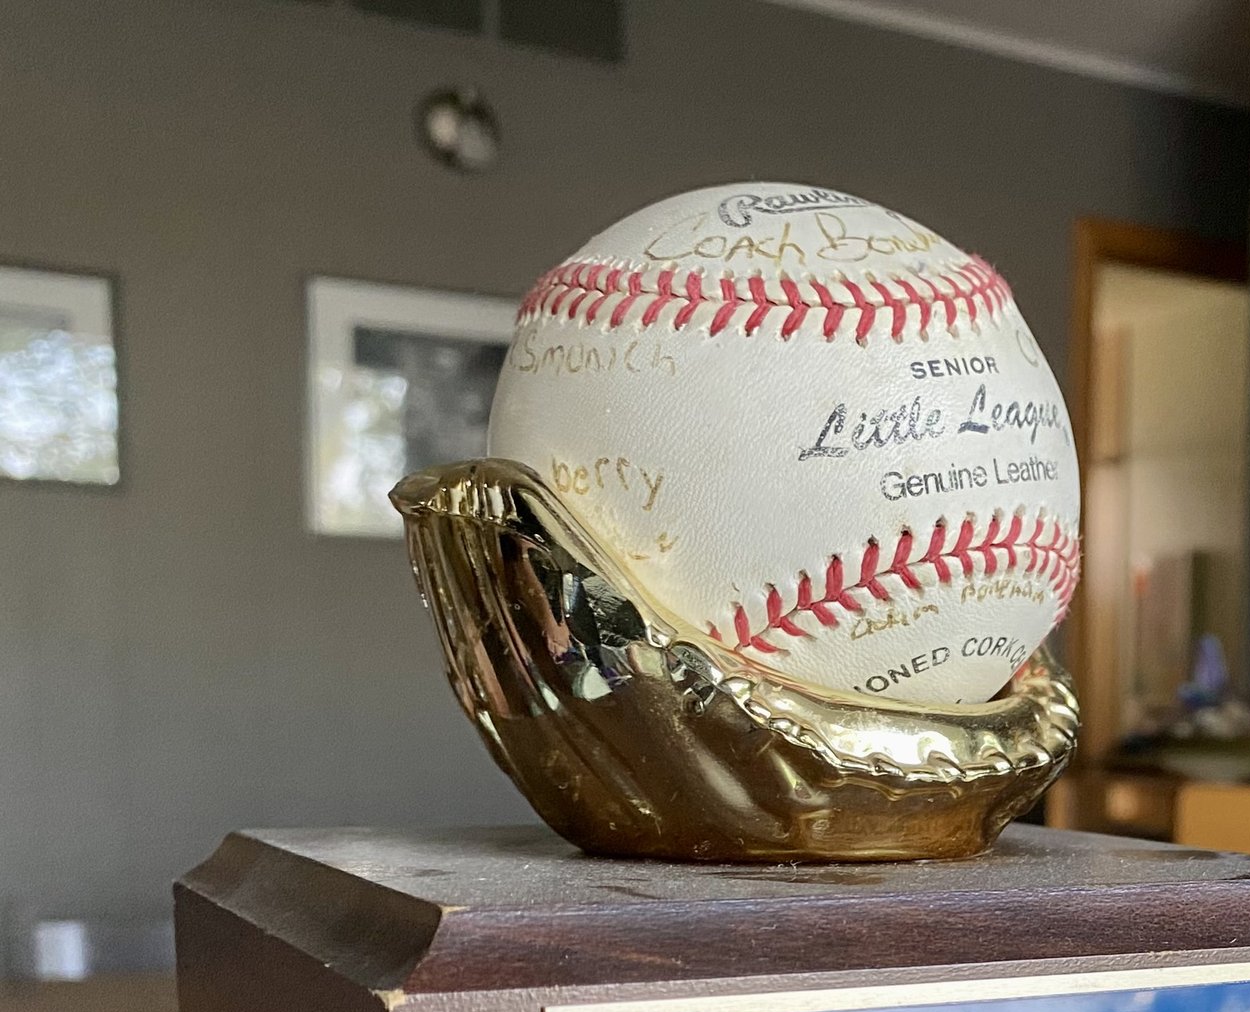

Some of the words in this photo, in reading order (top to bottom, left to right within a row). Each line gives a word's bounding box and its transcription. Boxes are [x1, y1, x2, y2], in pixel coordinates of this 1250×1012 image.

[909, 356, 1000, 379] SENIOR
[798, 395, 946, 462] Little
[957, 383, 1062, 446] League
[879, 463, 988, 501] Genuine
[853, 646, 951, 695] ONED
